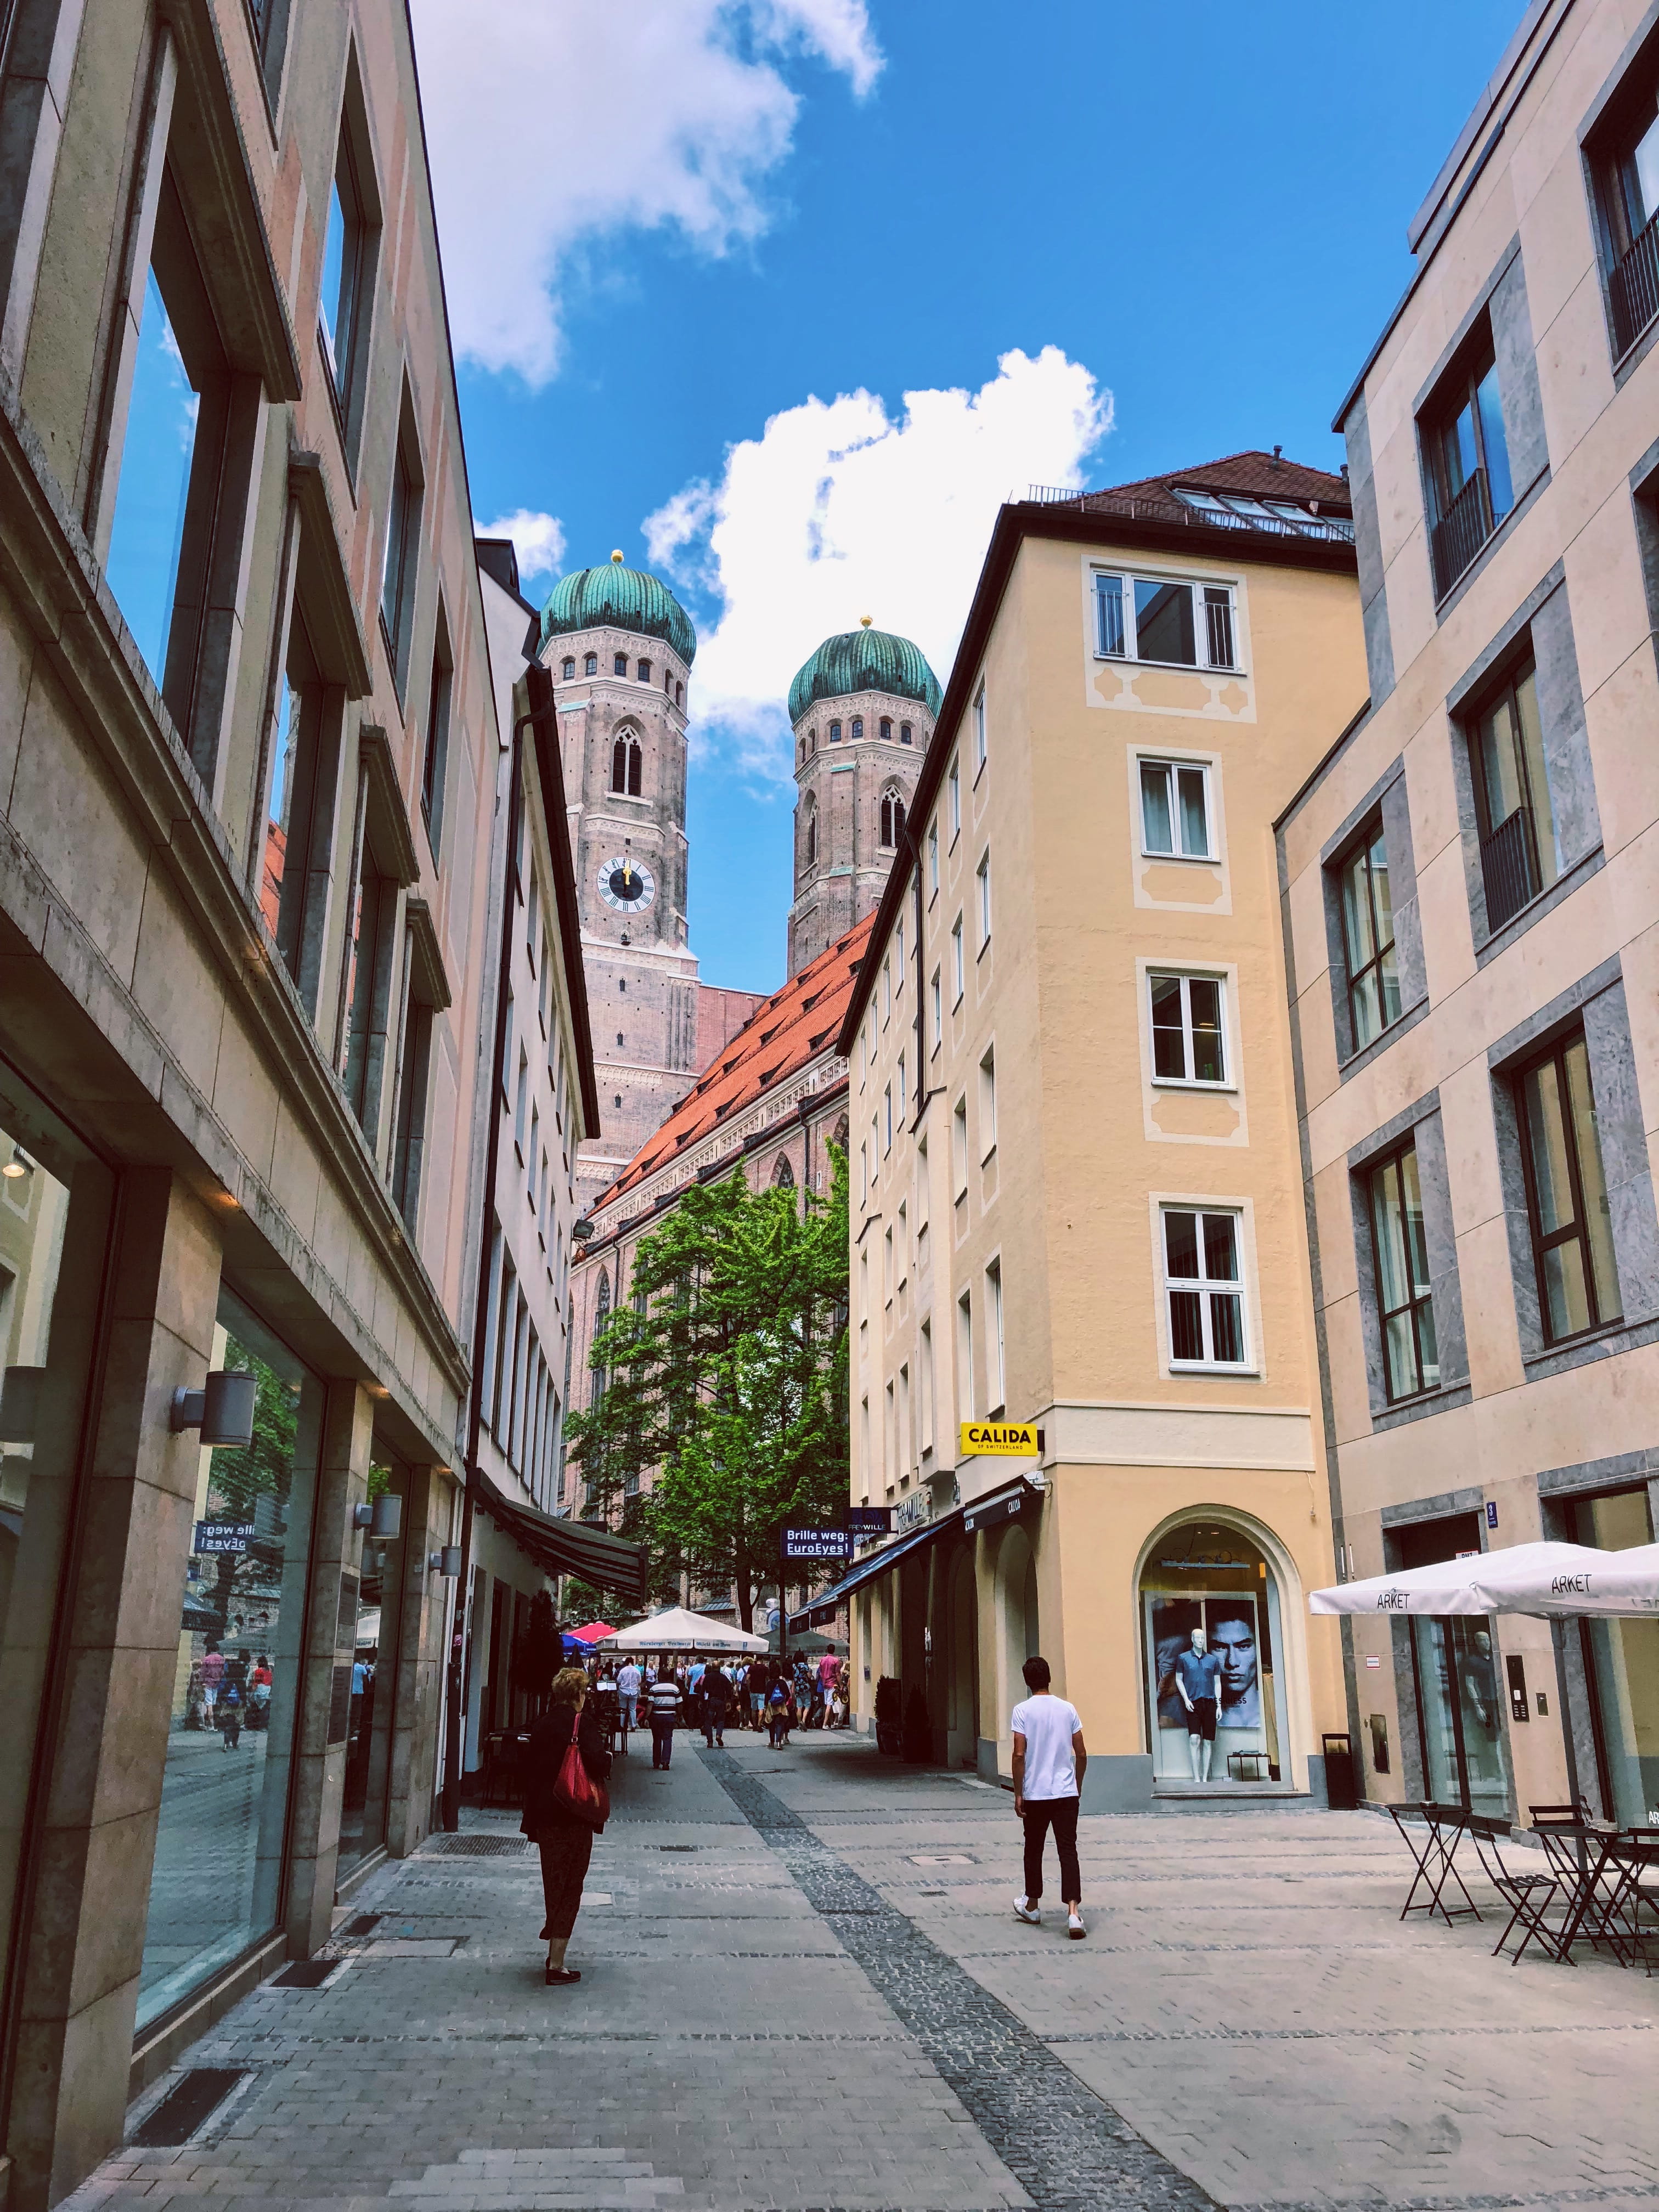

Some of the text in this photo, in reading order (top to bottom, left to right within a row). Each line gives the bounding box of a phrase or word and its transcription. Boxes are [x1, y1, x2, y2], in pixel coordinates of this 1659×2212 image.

[968, 1429, 1031, 1443] CALIDA
[1488, 1504, 1493, 1516] 3
[787, 1530, 817, 1540] Brille
[821, 1532, 848, 1542] weg:
[787, 1543, 848, 1555] EuroEyes!
[1552, 1574, 1592, 1594] ARKET
[1377, 1593, 1410, 1609] ARKET
